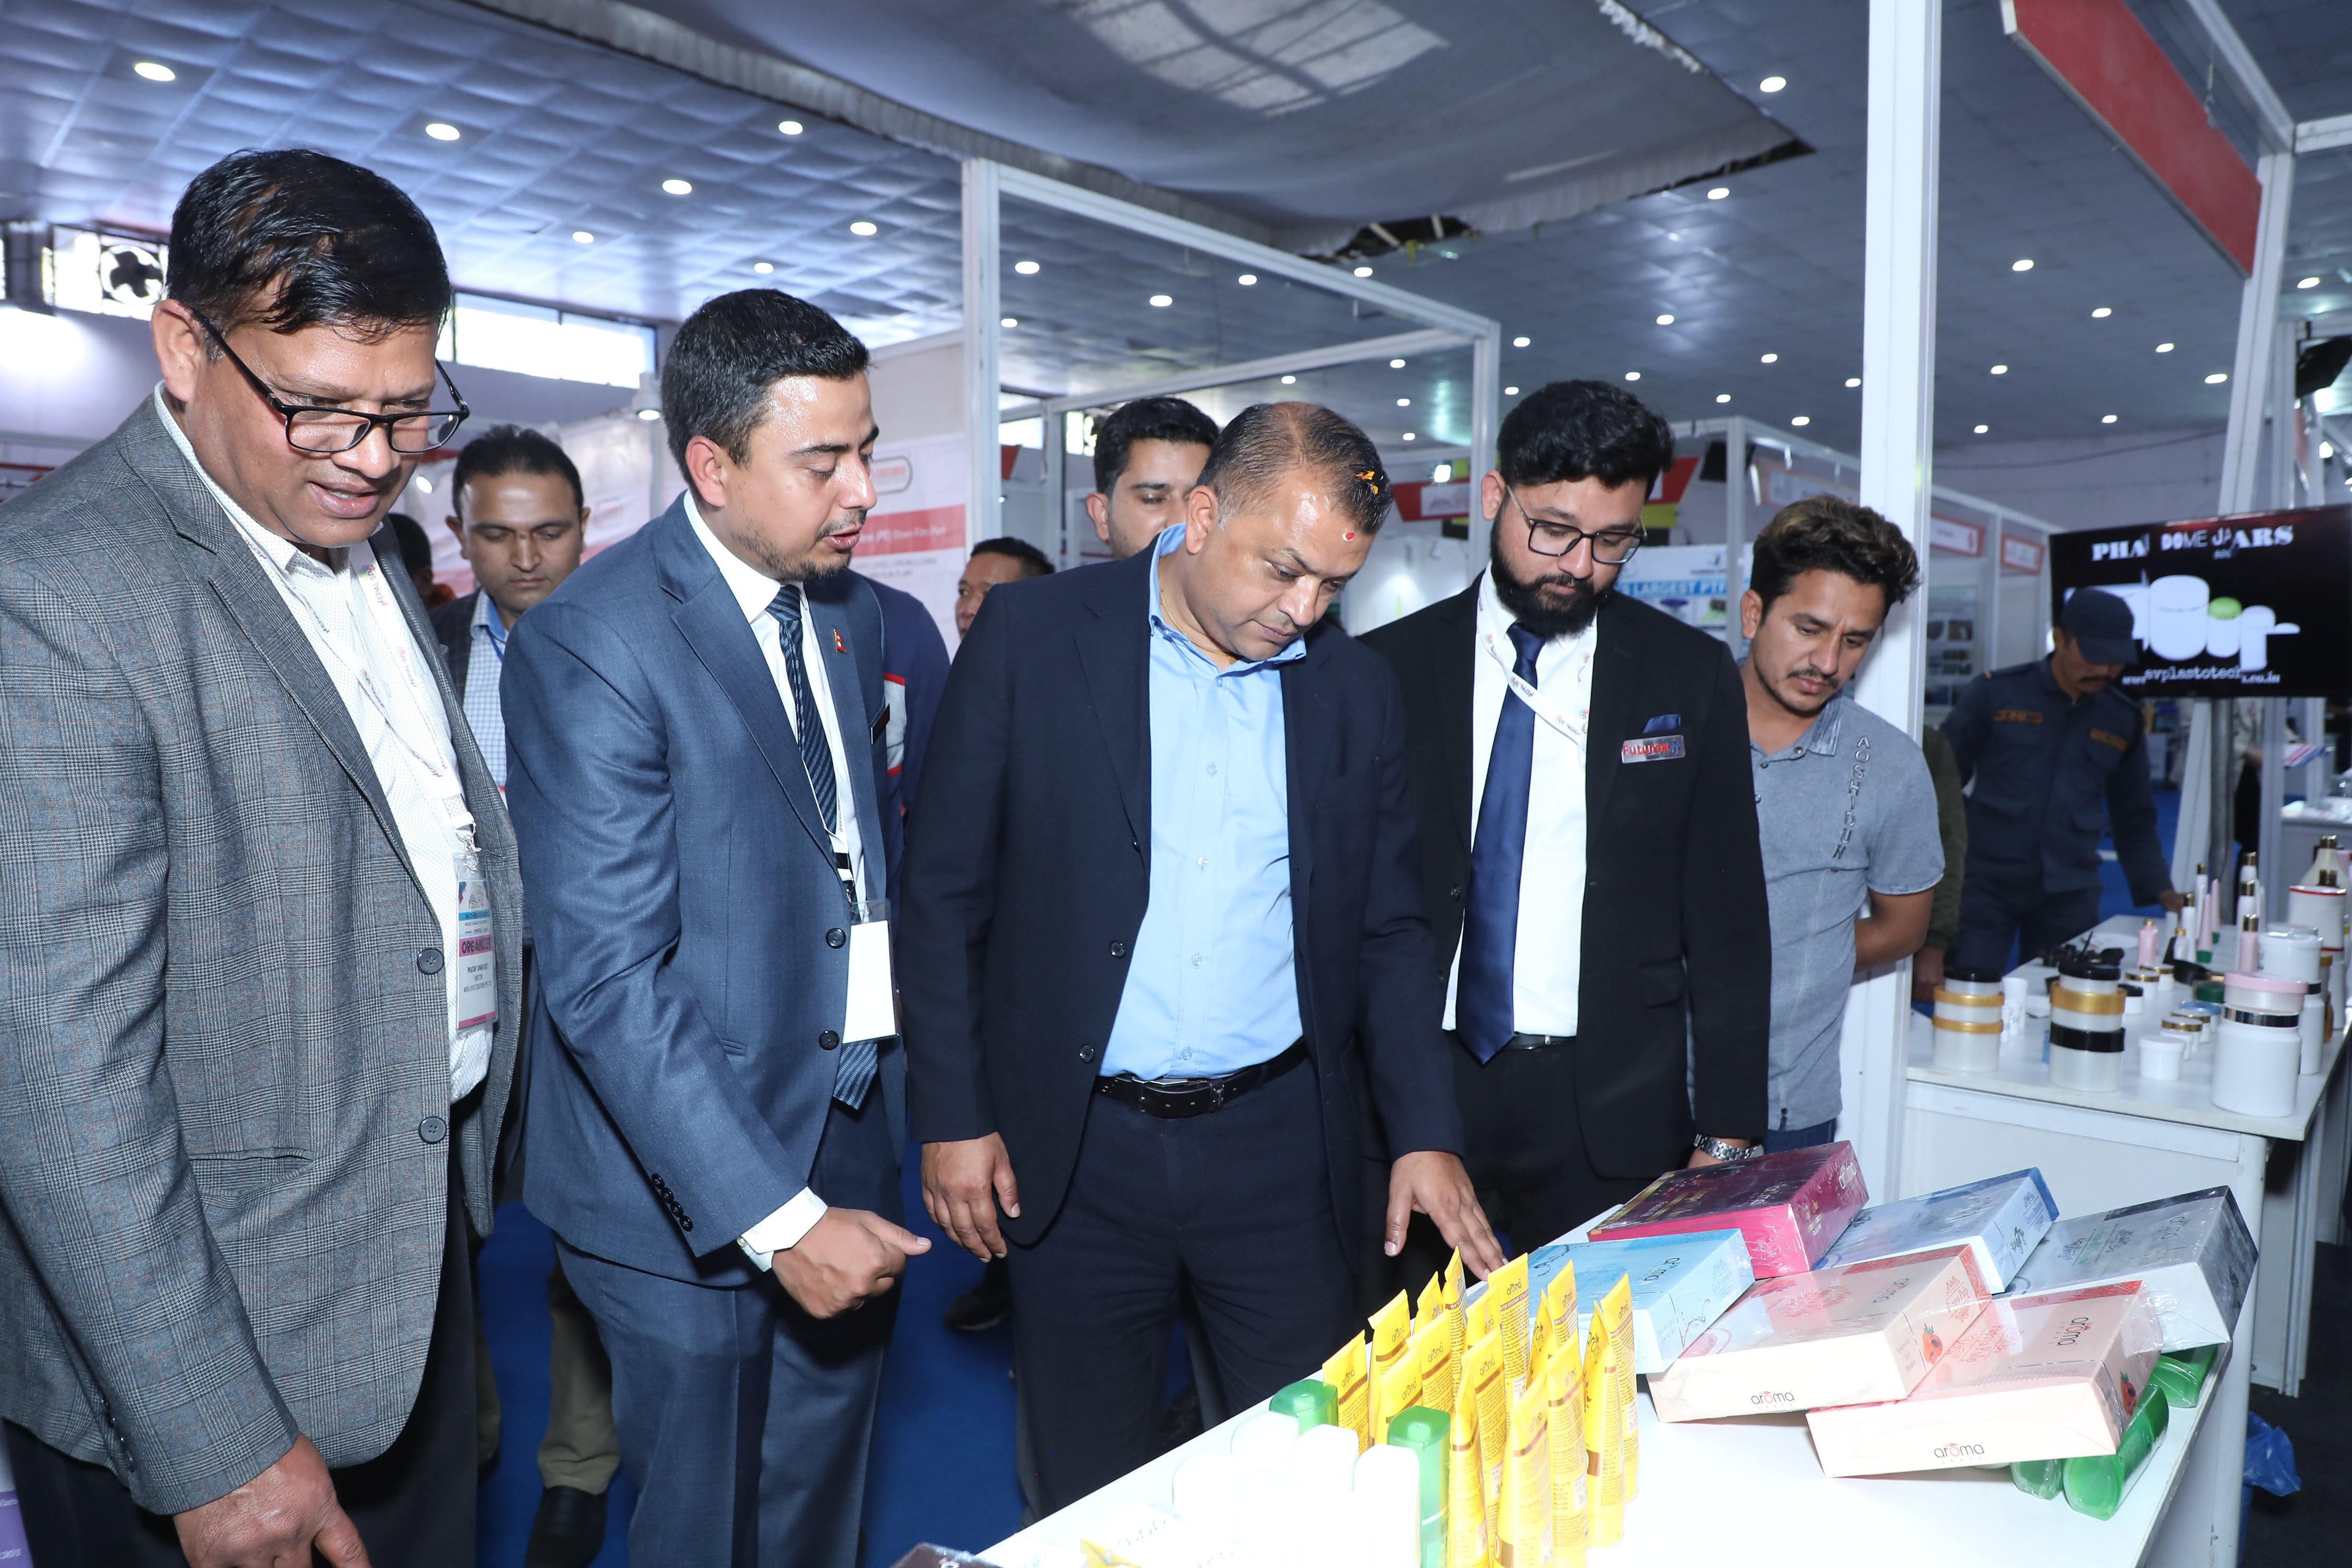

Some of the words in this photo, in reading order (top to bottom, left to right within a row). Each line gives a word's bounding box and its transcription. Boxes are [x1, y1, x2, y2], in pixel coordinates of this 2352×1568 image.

[2161, 530, 2208, 551] DOME
[1623, 743, 1670, 756] Futurex
[2056, 1317, 2090, 1346] aroma
[1428, 1345, 1444, 1363] aroma
[1957, 1346, 1993, 1363] Pulp
[1402, 1381, 1417, 1400] aroma
[1751, 1391, 1795, 1404] aroma
[1934, 1444, 1985, 1458] aroma
